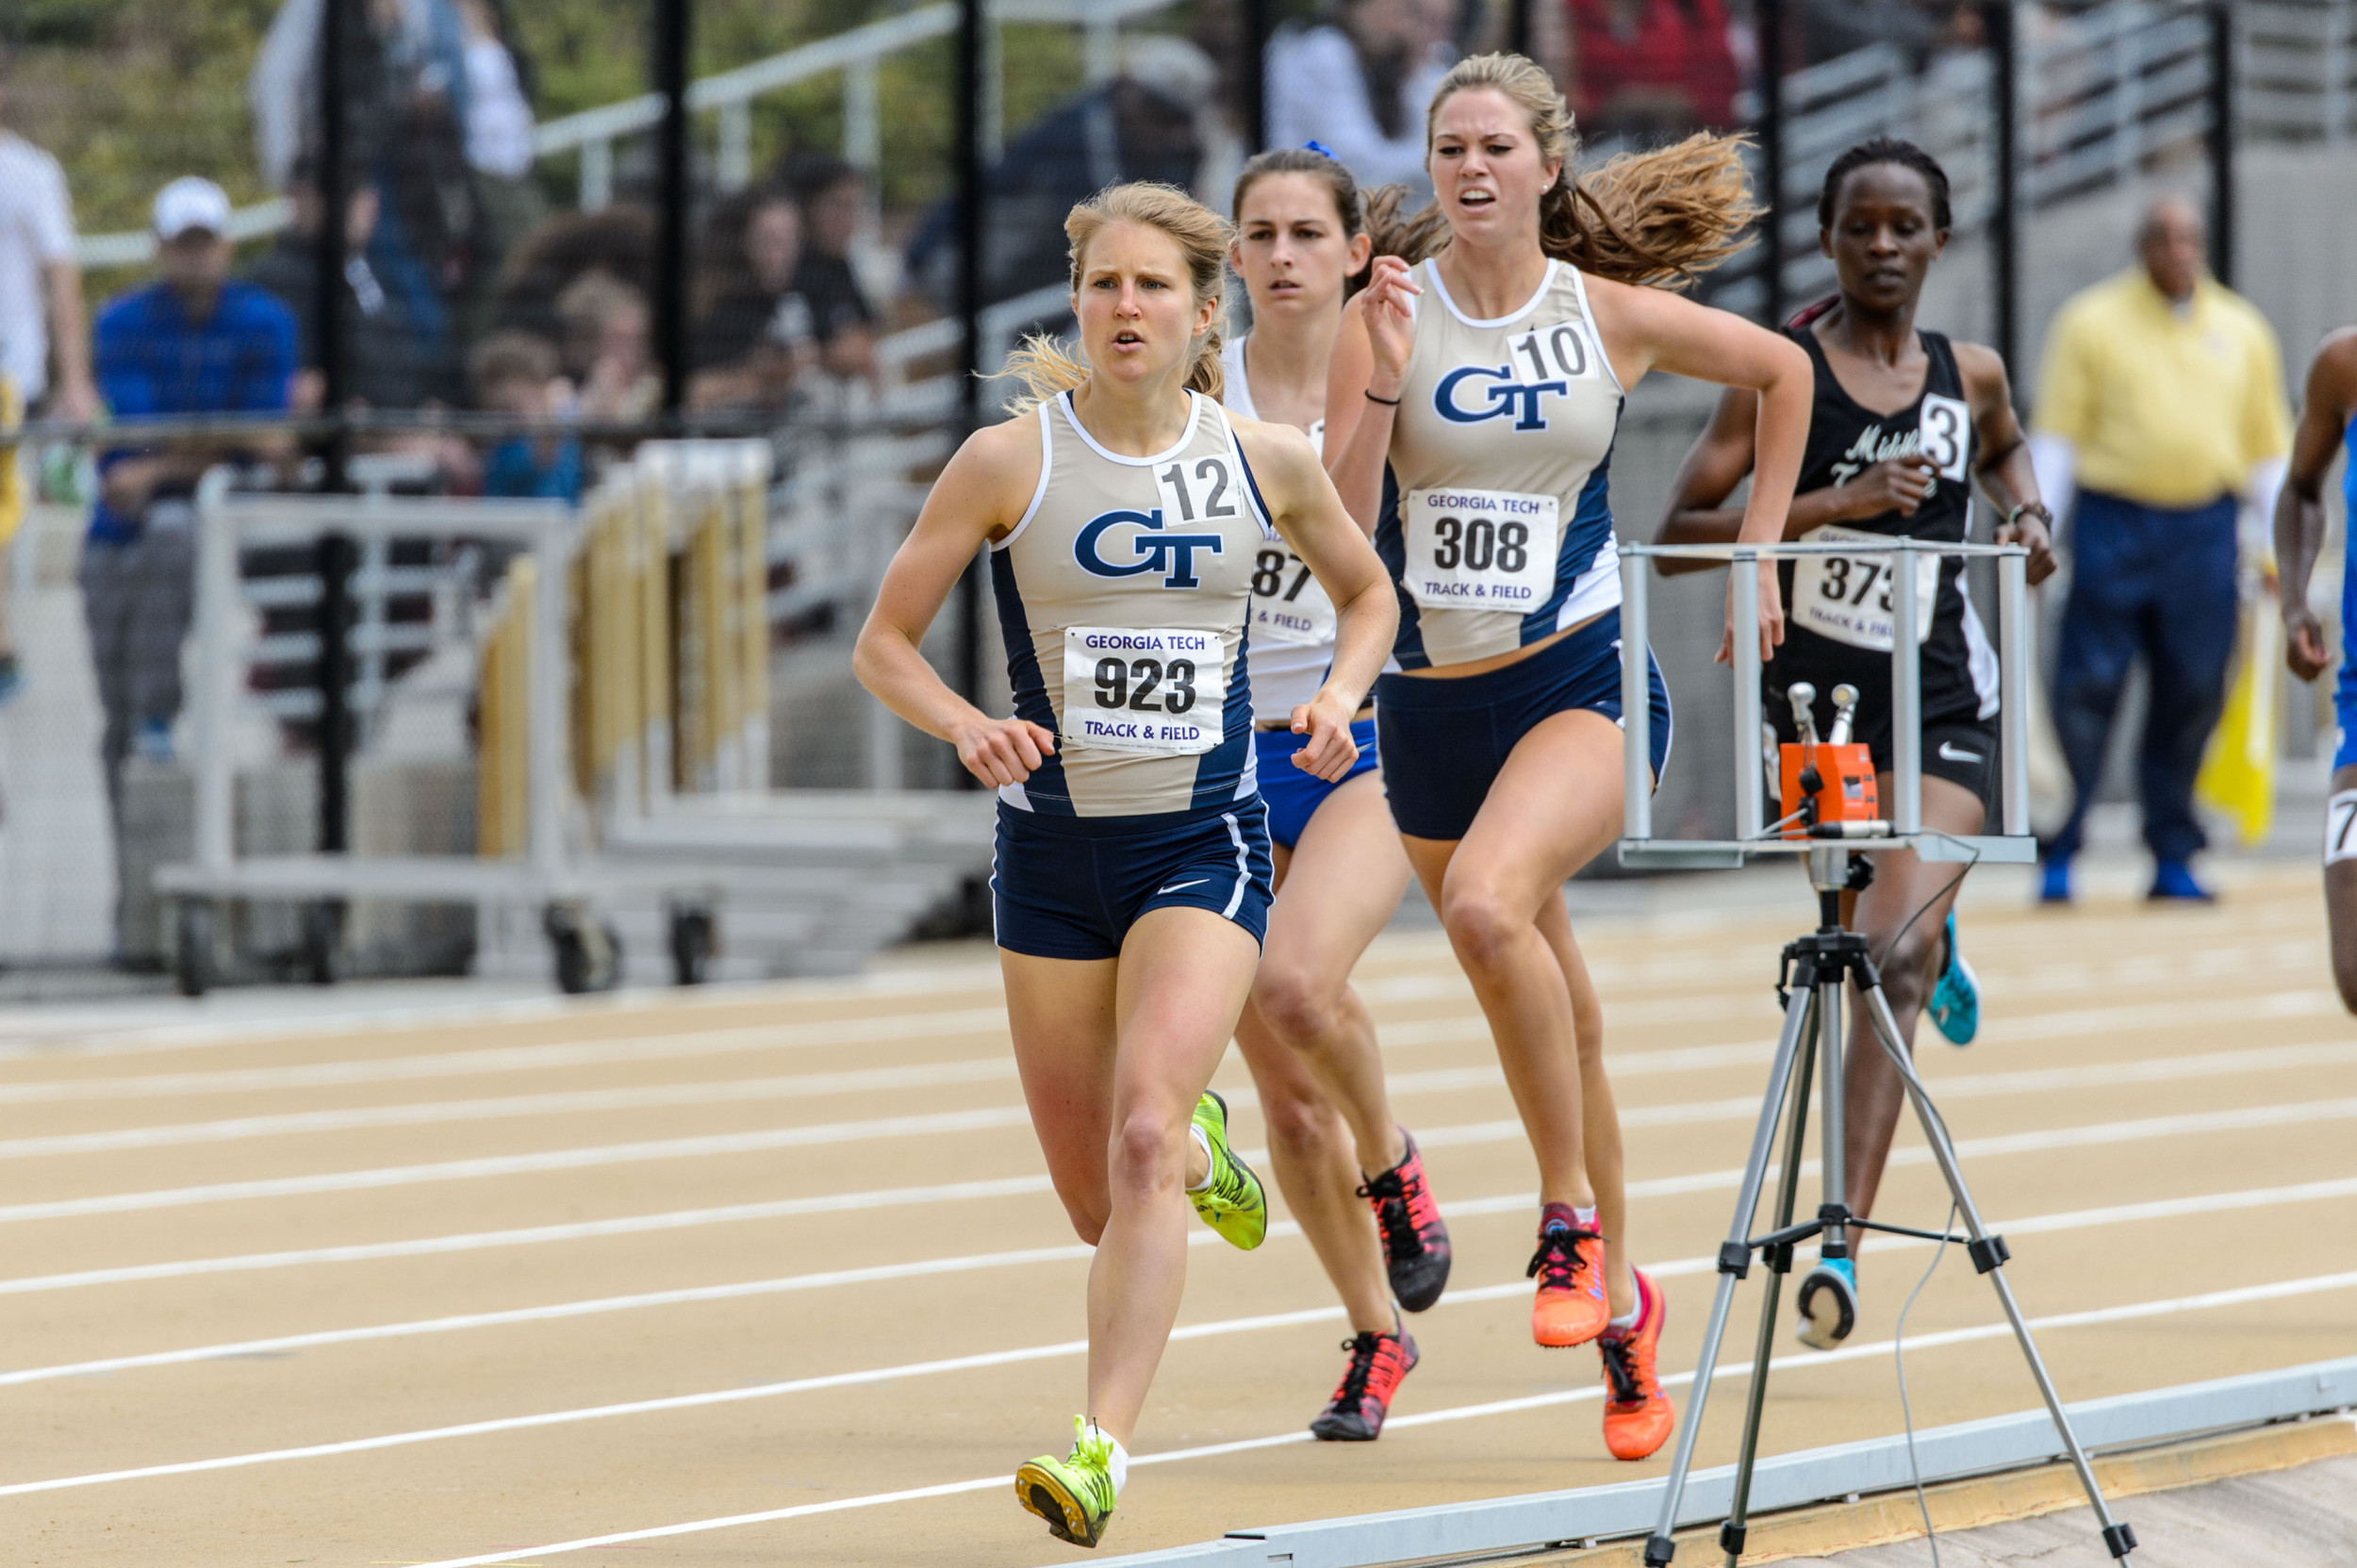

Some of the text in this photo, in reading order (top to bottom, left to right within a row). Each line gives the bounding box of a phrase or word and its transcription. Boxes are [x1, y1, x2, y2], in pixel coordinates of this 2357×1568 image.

[1517, 327, 1586, 380] 10
[1927, 405, 1958, 468] 3
[1162, 458, 1235, 521] 12
[1427, 494, 1540, 515] GEORGIA TECH
[1072, 508, 1224, 589] GT
[1434, 517, 1528, 573] 308
[1252, 550, 1311, 602] 87
[1424, 582, 1532, 600] TRACK & FIELD
[1085, 635, 1205, 651] GEORGIA TECH
[1274, 613, 1312, 631] FIELD
[1095, 657, 1196, 714] 923
[1085, 721, 1200, 740] TRACK & FIELD
